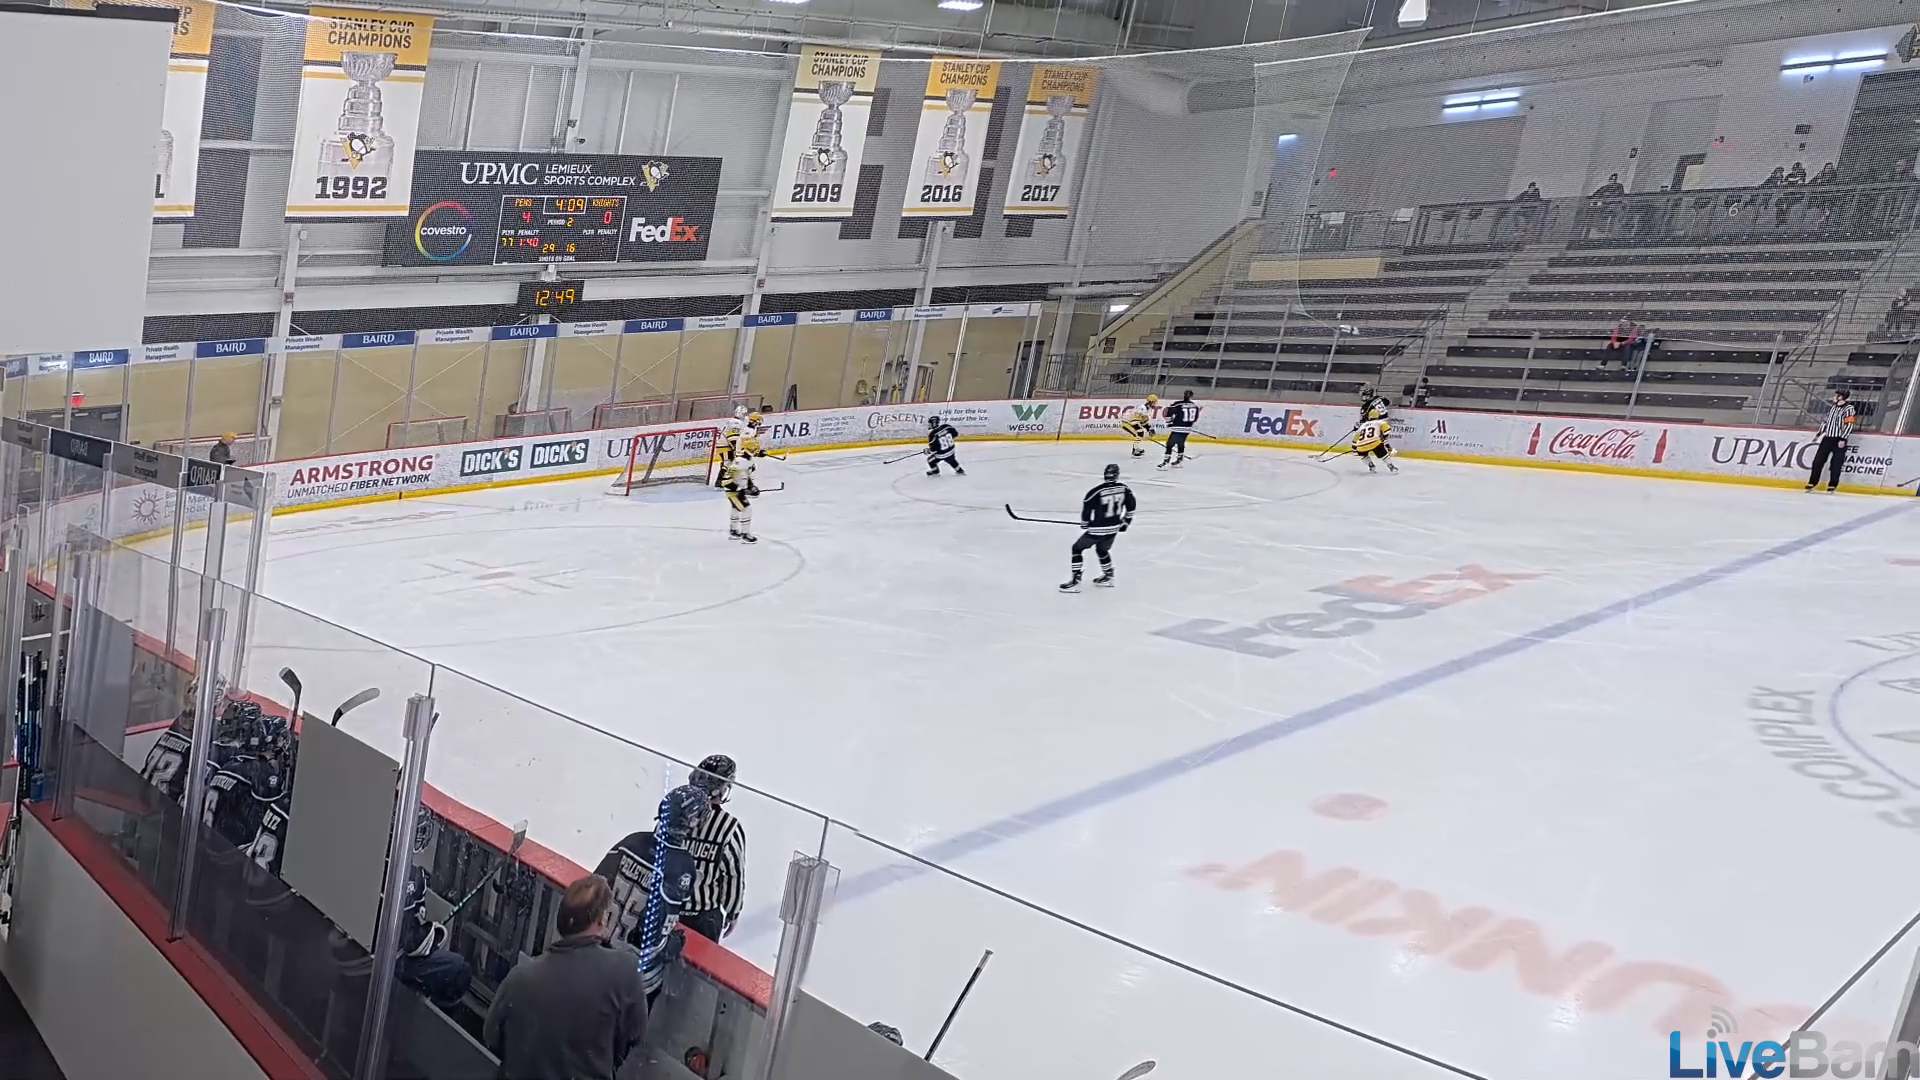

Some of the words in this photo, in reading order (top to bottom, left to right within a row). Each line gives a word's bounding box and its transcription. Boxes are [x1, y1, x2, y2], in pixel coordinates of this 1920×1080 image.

[328, 16, 380, 33] STANLEY
[383, 20, 415, 34] CUP
[327, 30, 412, 49] CHAMPIONS
[813, 51, 851, 64] STANLEY
[852, 54, 869, 66] CUP
[811, 64, 866, 79] CHAMPIONS
[943, 62, 975, 74] STANLEY
[976, 63, 991, 74] CUP
[1043, 69, 1073, 80] STANLEY
[1074, 71, 1089, 81] CUP
[940, 73, 988, 86] CHAMPIONS
[1041, 79, 1086, 92] CHAMPIONS
[460, 162, 540, 185] UPMC
[545, 163, 592, 175] LEMIEUX
[544, 174, 586, 186] SPORTS
[588, 175, 636, 187] COMPLEX
[314, 176, 388, 200] 1992
[791, 183, 842, 202] 2009
[920, 184, 963, 202] 2016
[1021, 184, 1061, 202] 2017
[522, 212, 531, 223] 4
[567, 217, 574, 227] 2
[603, 211, 613, 224] 0
[420, 224, 467, 236] covestro
[629, 216, 700, 243] FedEx
[501, 237, 515, 247] 77
[542, 243, 556, 253] 29
[535, 289, 575, 307] 12:49
[758, 314, 782, 324] BAIRD
[860, 310, 886, 320] BAIRD
[510, 326, 539, 337] BAIRD
[640, 320, 668, 331] BAIRD
[362, 333, 395, 345] BAIRD
[216, 342, 247, 353] BAIRD
[284, 343, 320, 351] Management
[89, 351, 114, 362] BAIRD
[965, 407, 976, 415] the
[1182, 408, 1197, 423] 18
[867, 411, 926, 429] CRESCENT
[1244, 407, 1319, 438] FedEx
[772, 422, 811, 440] F.N.B.
[1009, 423, 1044, 432] wesco
[683, 439, 713, 451] MEDIC
[1549, 426, 1645, 460] Coca-Cola
[464, 447, 519, 473] DICK'S
[533, 441, 585, 466] DICK'S
[1711, 436, 1819, 471] UPMC
[290, 454, 434, 486] ARMSTRONG
[1841, 465, 1884, 475] EDICINE
[287, 482, 349, 498] UNMATCHED
[349, 478, 379, 491] FIBER
[380, 473, 431, 487] NETWORK
[1100, 493, 1126, 518] 77
[1147, 564, 1551, 659] FedEx
[1746, 684, 1904, 801] COMPLEX
